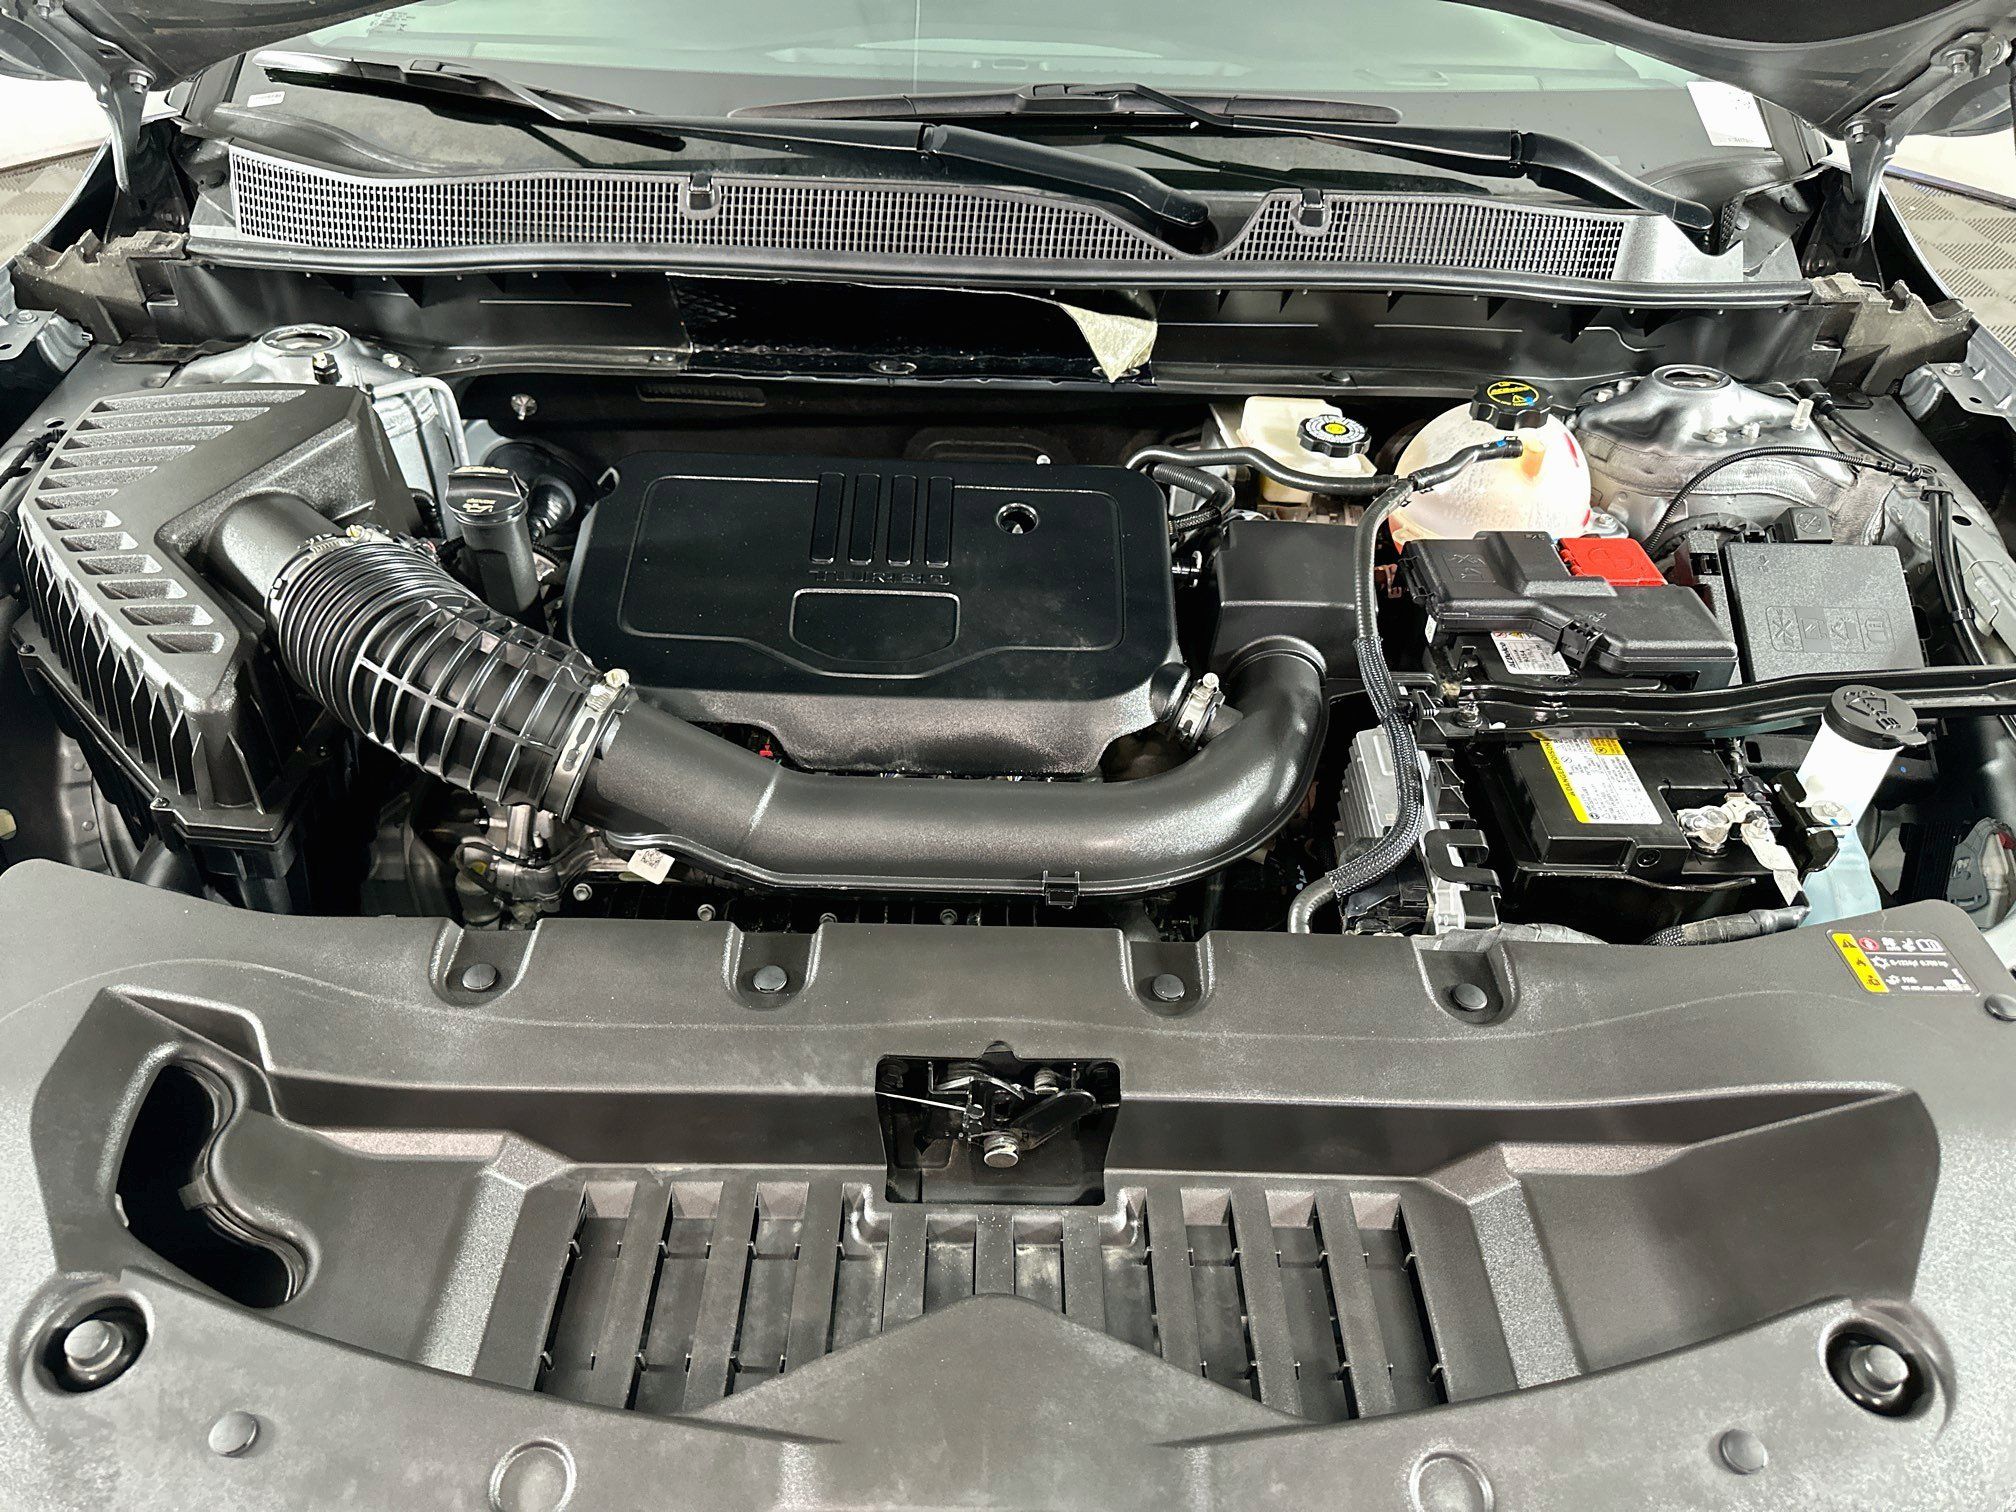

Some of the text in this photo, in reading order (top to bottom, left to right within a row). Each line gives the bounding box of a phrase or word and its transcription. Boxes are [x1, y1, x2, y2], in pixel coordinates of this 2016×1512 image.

[808, 570, 951, 586] TURBO
[1545, 741, 1574, 792] DANGER POISON
